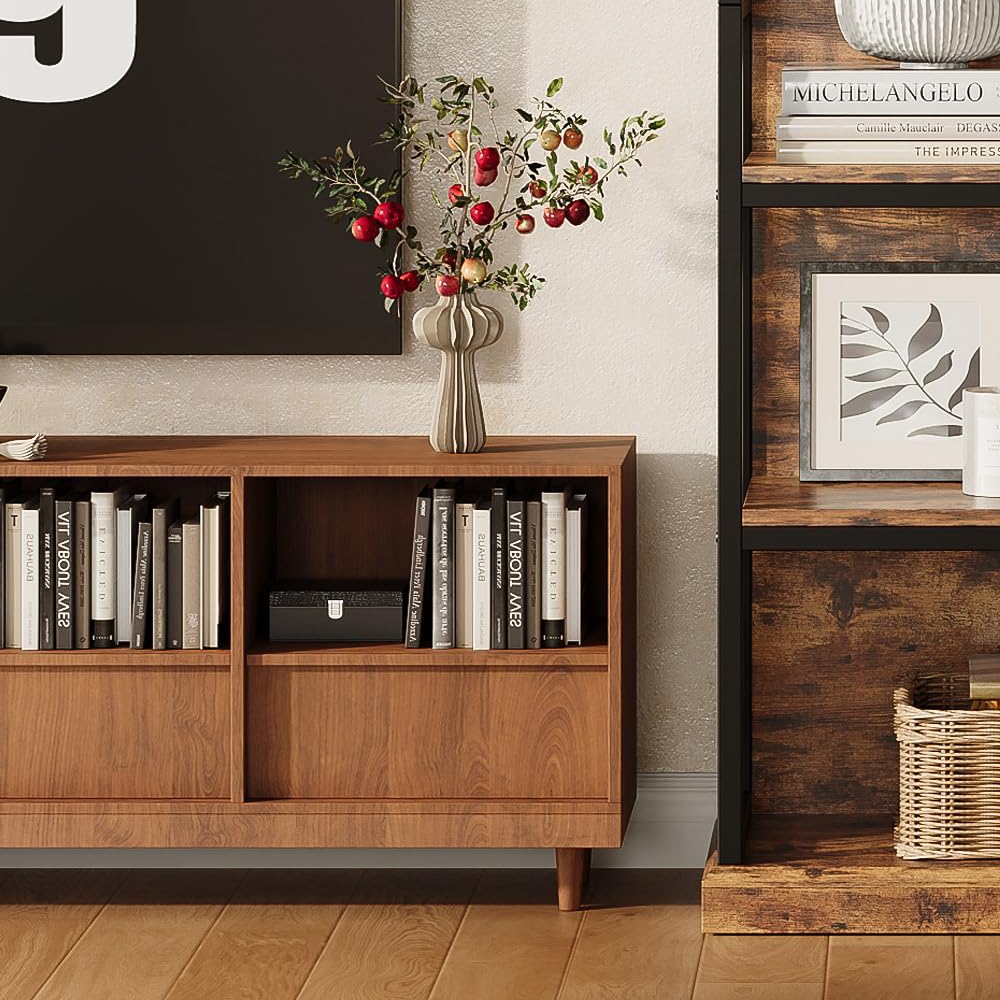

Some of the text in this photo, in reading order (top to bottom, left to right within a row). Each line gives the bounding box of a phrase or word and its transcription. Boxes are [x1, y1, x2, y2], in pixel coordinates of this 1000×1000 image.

[792, 82, 984, 102] MICHELANGELO
[856, 122, 945, 134] Camille Mauclair
[915, 146, 940, 157] THE
[10, 514, 18, 527] T
[461, 514, 469, 527] T
